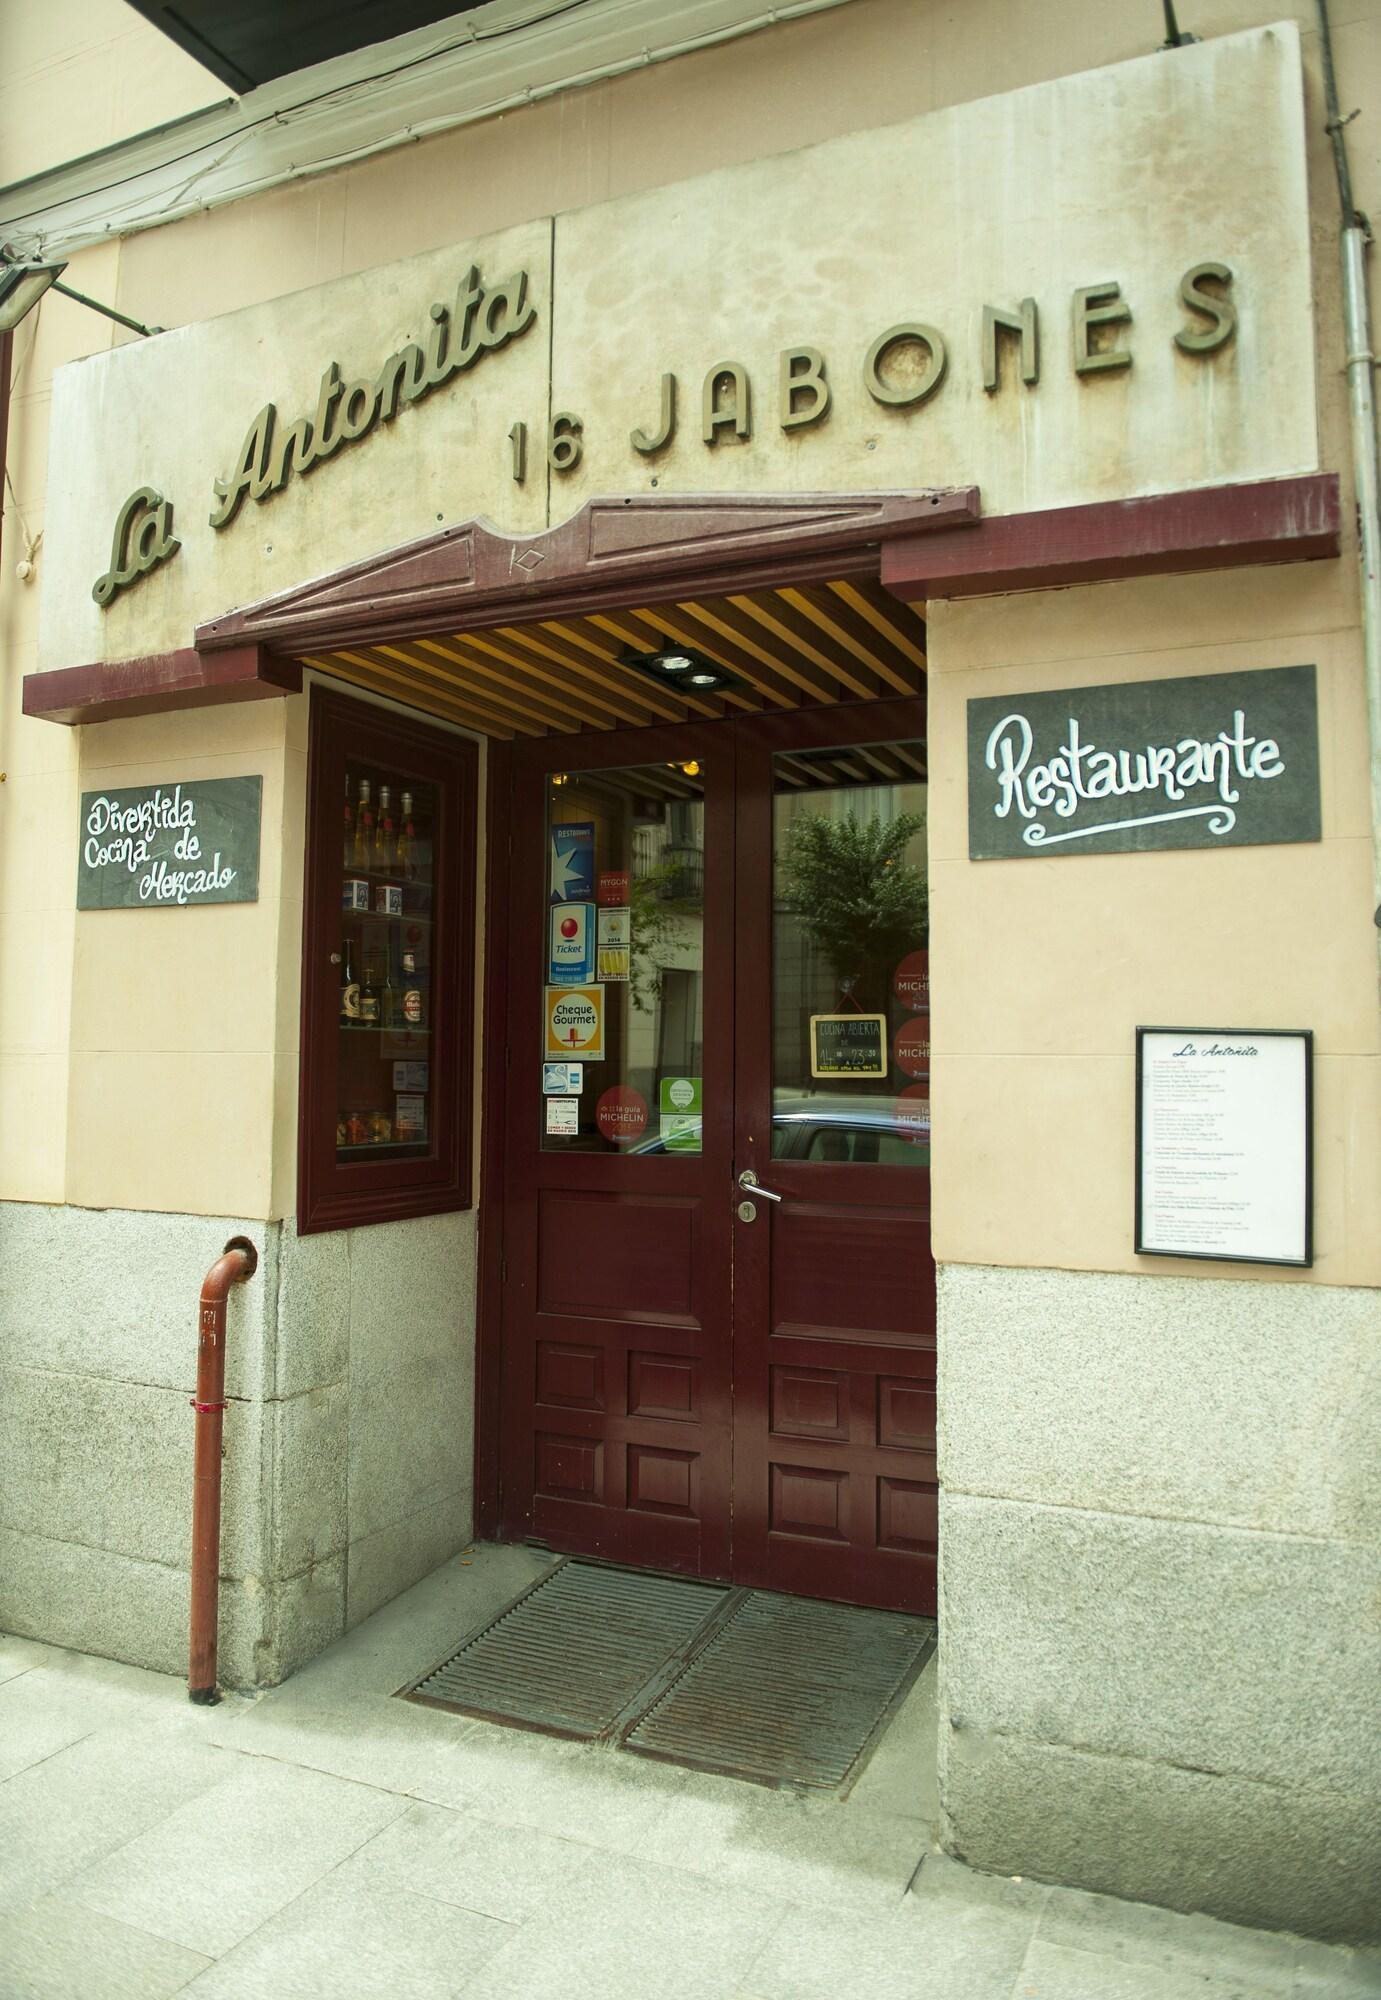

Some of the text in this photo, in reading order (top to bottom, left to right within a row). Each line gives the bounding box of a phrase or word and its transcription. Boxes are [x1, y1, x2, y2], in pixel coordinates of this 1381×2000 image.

[508, 262, 1236, 483] 16 JABONES
[92, 486, 182, 607] La
[986, 710, 1285, 818] Restaurante
[87, 785, 196, 841] Divertida
[85, 827, 201, 872] Cocina de
[140, 852, 237, 904] Mercado
[556, 944, 582, 954] Ticket
[553, 1015, 596, 1025] Gourmet
[556, 1005, 593, 1016] Cheque
[848, 1022, 880, 1035] ABIERTA
[1172, 1043, 1196, 1057] La
[600, 1113, 644, 1122] MICHELIN
